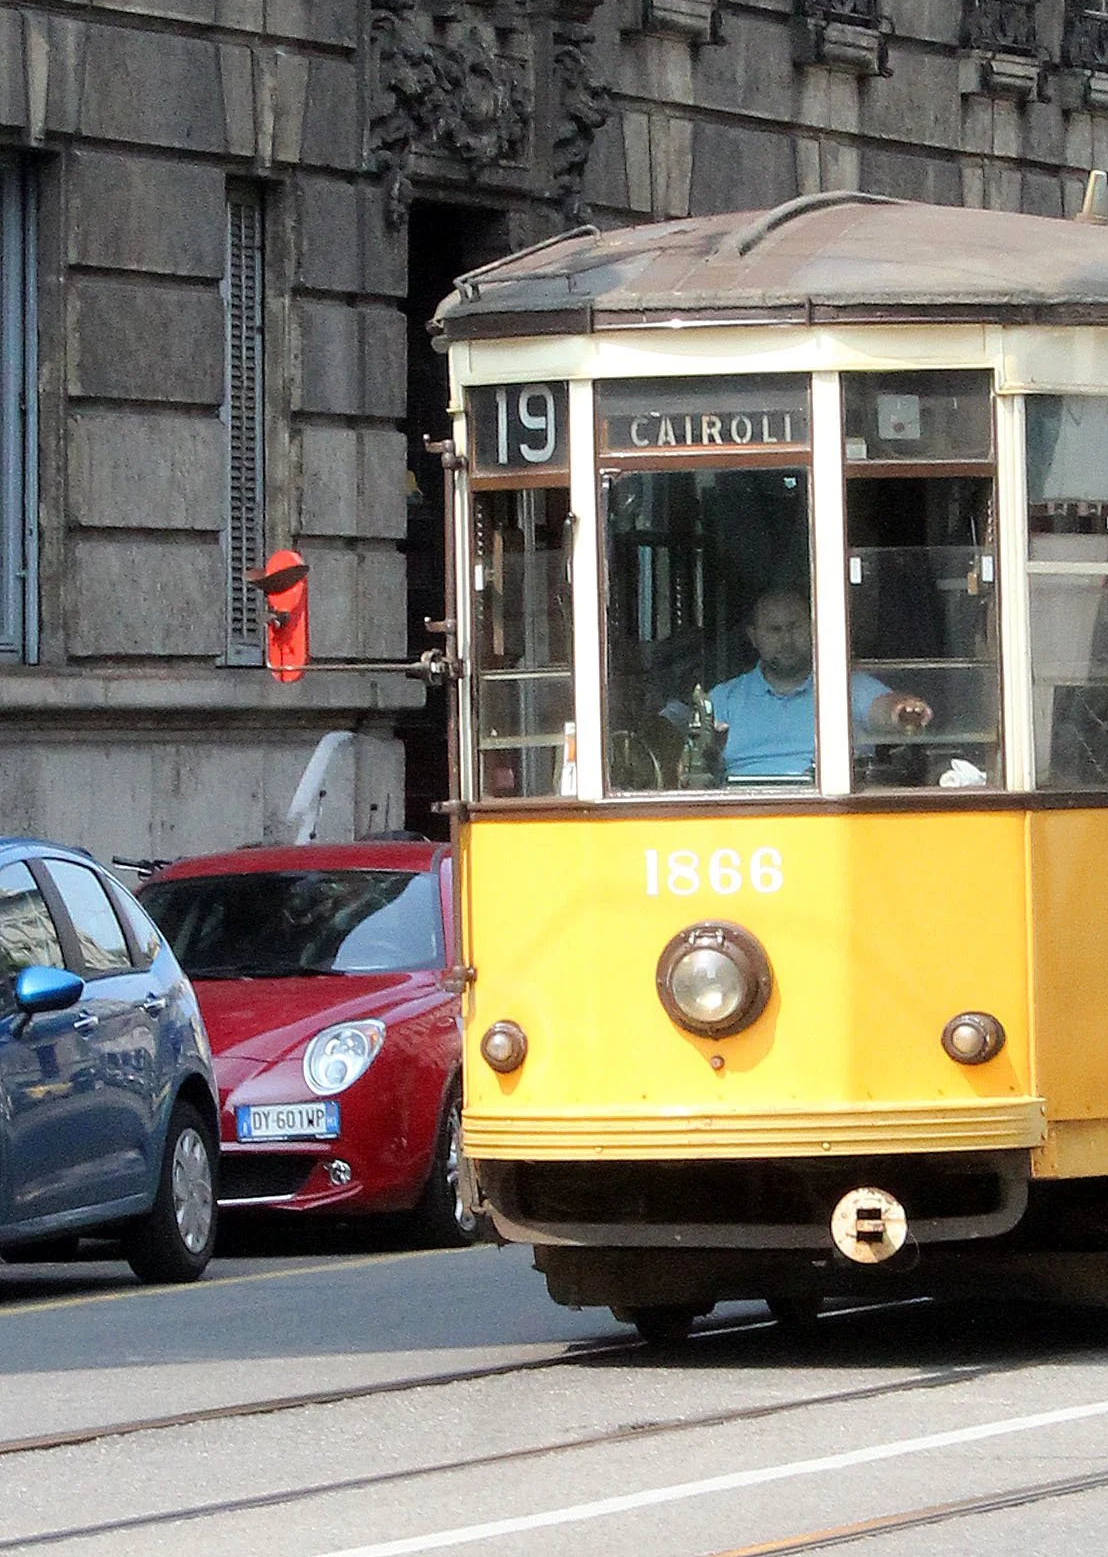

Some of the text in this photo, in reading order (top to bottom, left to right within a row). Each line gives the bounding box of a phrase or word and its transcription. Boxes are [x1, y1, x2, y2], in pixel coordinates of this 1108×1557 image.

[495, 383, 556, 465] 19
[629, 414, 792, 447] CAIROLI
[644, 845, 784, 897] 1866
[252, 1110, 271, 1130] DY
